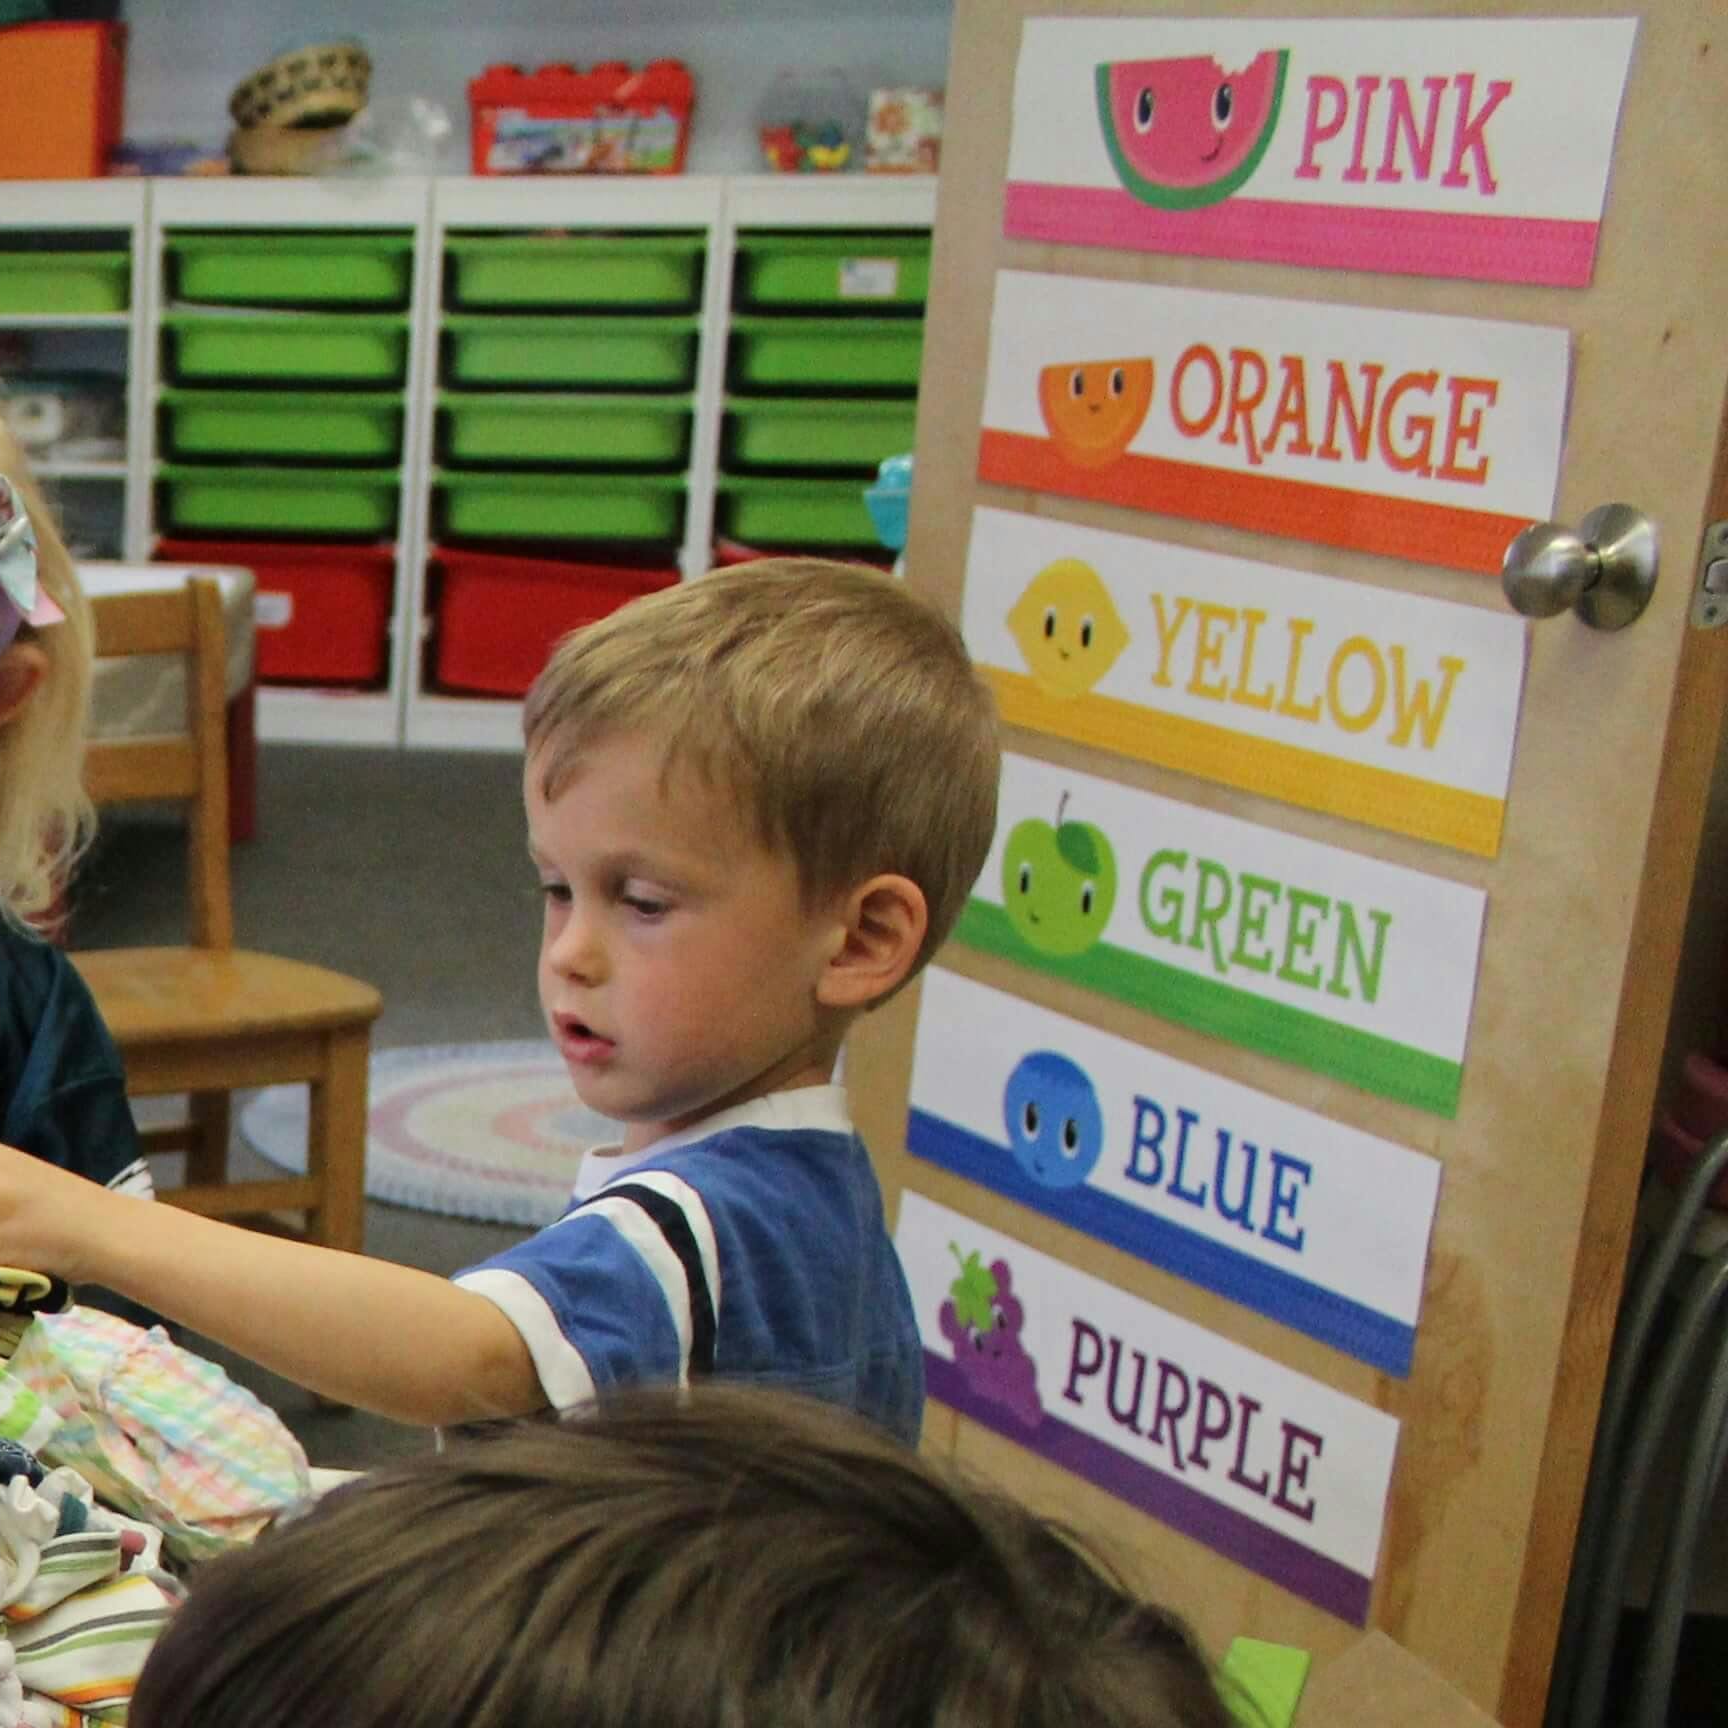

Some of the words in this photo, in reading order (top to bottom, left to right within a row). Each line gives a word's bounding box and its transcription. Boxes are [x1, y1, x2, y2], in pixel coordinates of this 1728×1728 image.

[1294, 71, 1514, 196] PINK
[1169, 342, 1501, 486] ORANGE
[1148, 592, 1465, 752] YELLOW
[1137, 846, 1393, 1006] GREEN
[1123, 1093, 1313, 1254] BLUE
[1061, 1318, 1326, 1525] PURPLE
